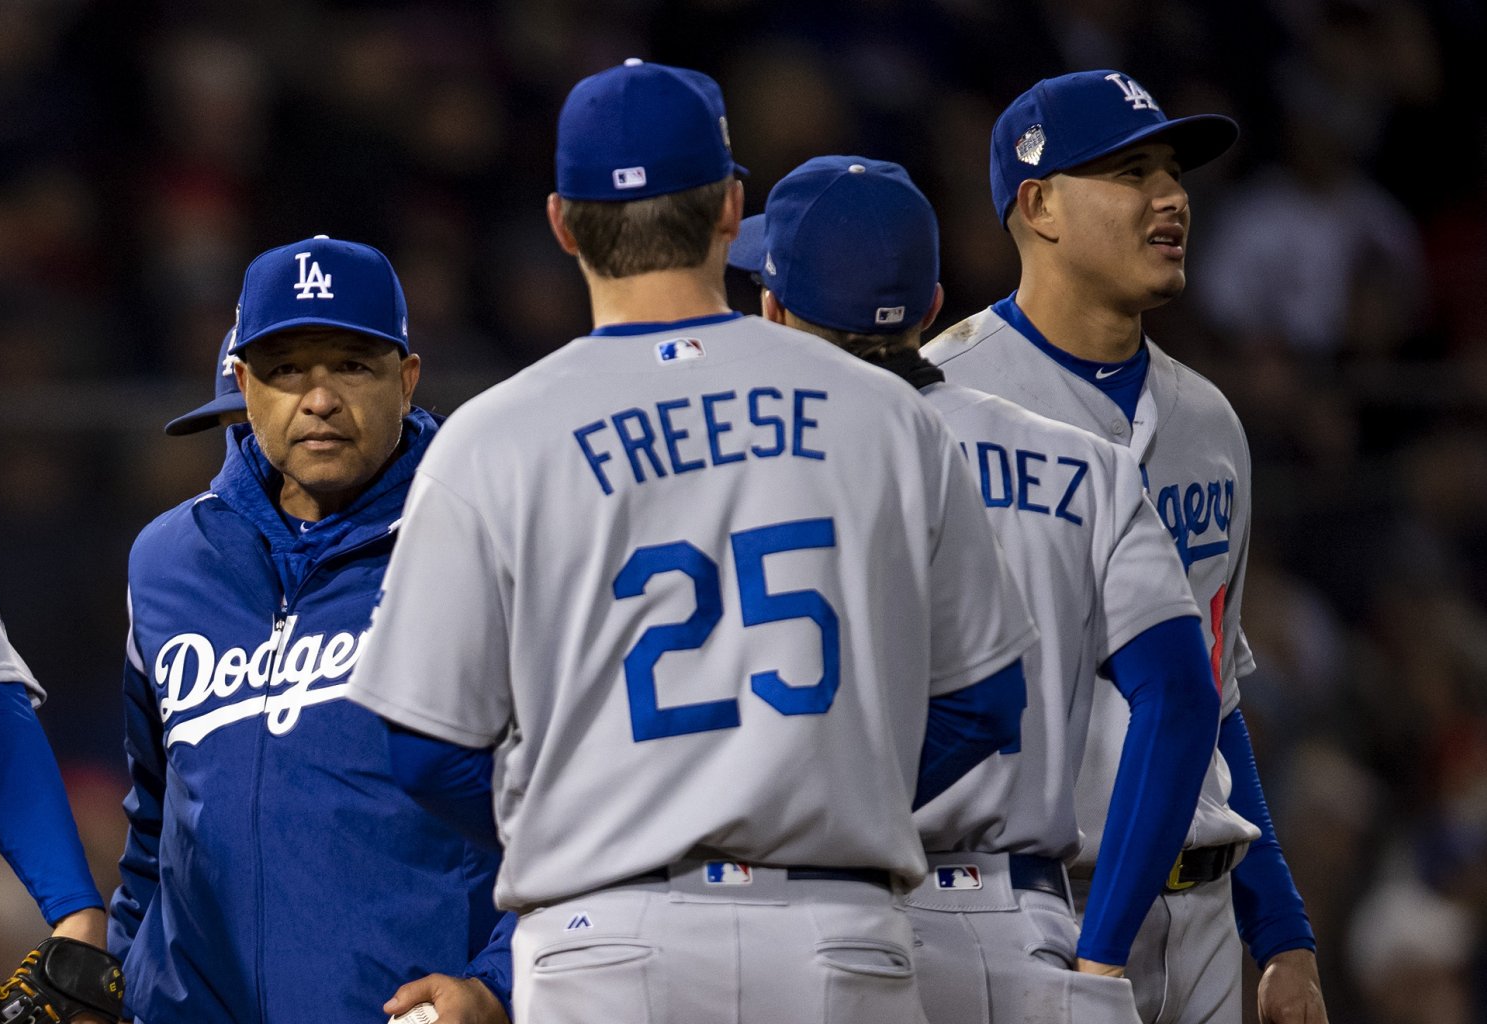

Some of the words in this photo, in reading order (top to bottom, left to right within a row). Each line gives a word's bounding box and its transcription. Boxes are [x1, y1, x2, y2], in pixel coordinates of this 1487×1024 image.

[1104, 73, 1160, 111] LA
[293, 252, 335, 299] LA
[573, 387, 828, 496] FREESE
[961, 441, 1089, 527] DEZ
[154, 614, 371, 735] Dodge
[612, 517, 841, 743] 25
